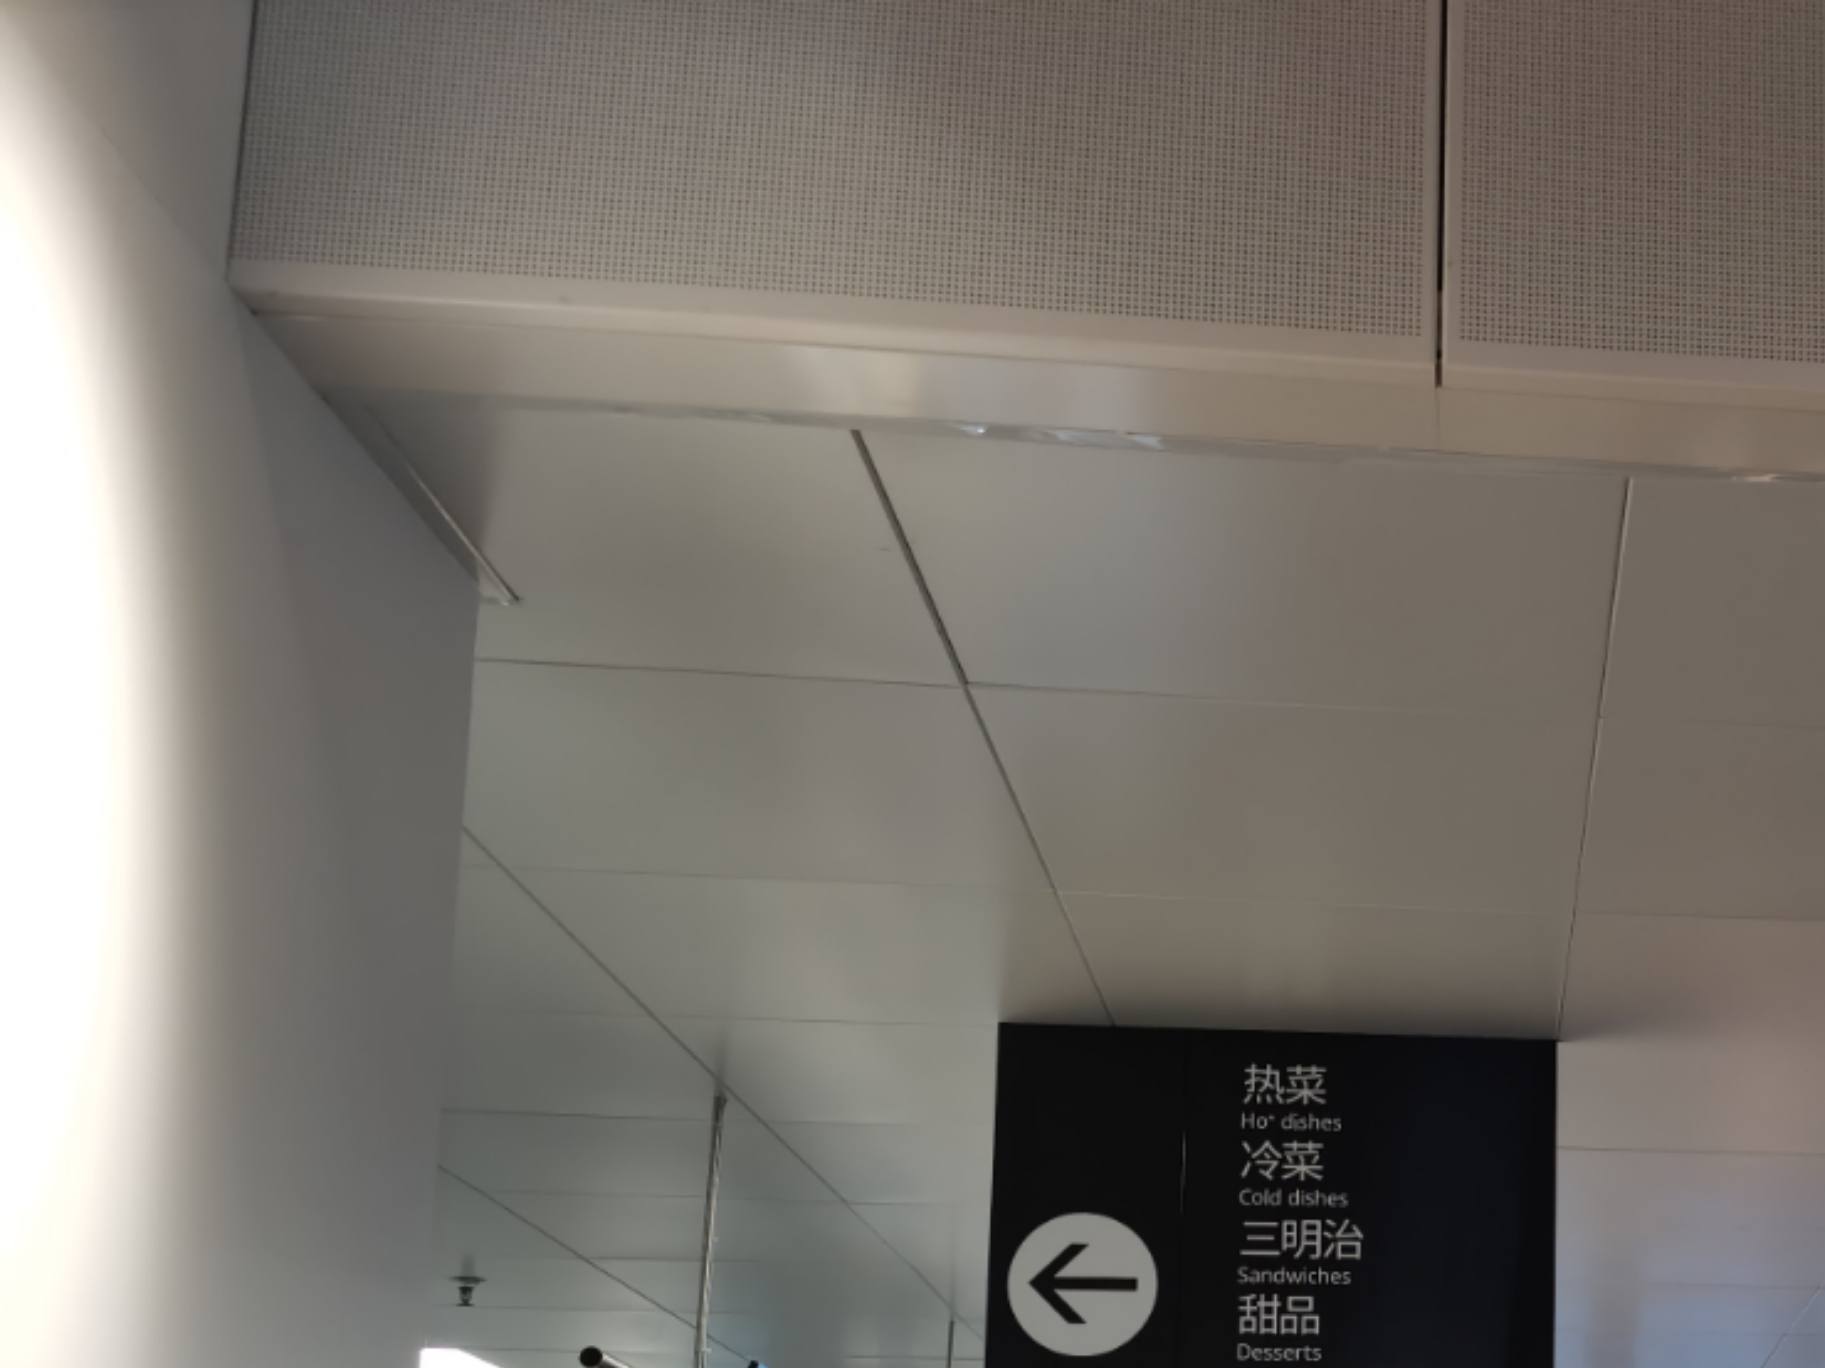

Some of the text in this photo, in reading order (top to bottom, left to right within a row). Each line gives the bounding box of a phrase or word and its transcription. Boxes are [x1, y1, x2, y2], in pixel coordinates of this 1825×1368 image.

[1243, 1063, 1327, 1105] 热菜
[1241, 1112, 1342, 1133] Ho dishes
[1240, 1140, 1324, 1181] 冷菜
[1239, 1188, 1348, 1208] Cold dishes
[1239, 1219, 1364, 1260] 三明治
[1237, 1266, 1352, 1286] Sandwiches
[1238, 1294, 1320, 1335] 甜品
[1237, 1343, 1323, 1361] Desserts
